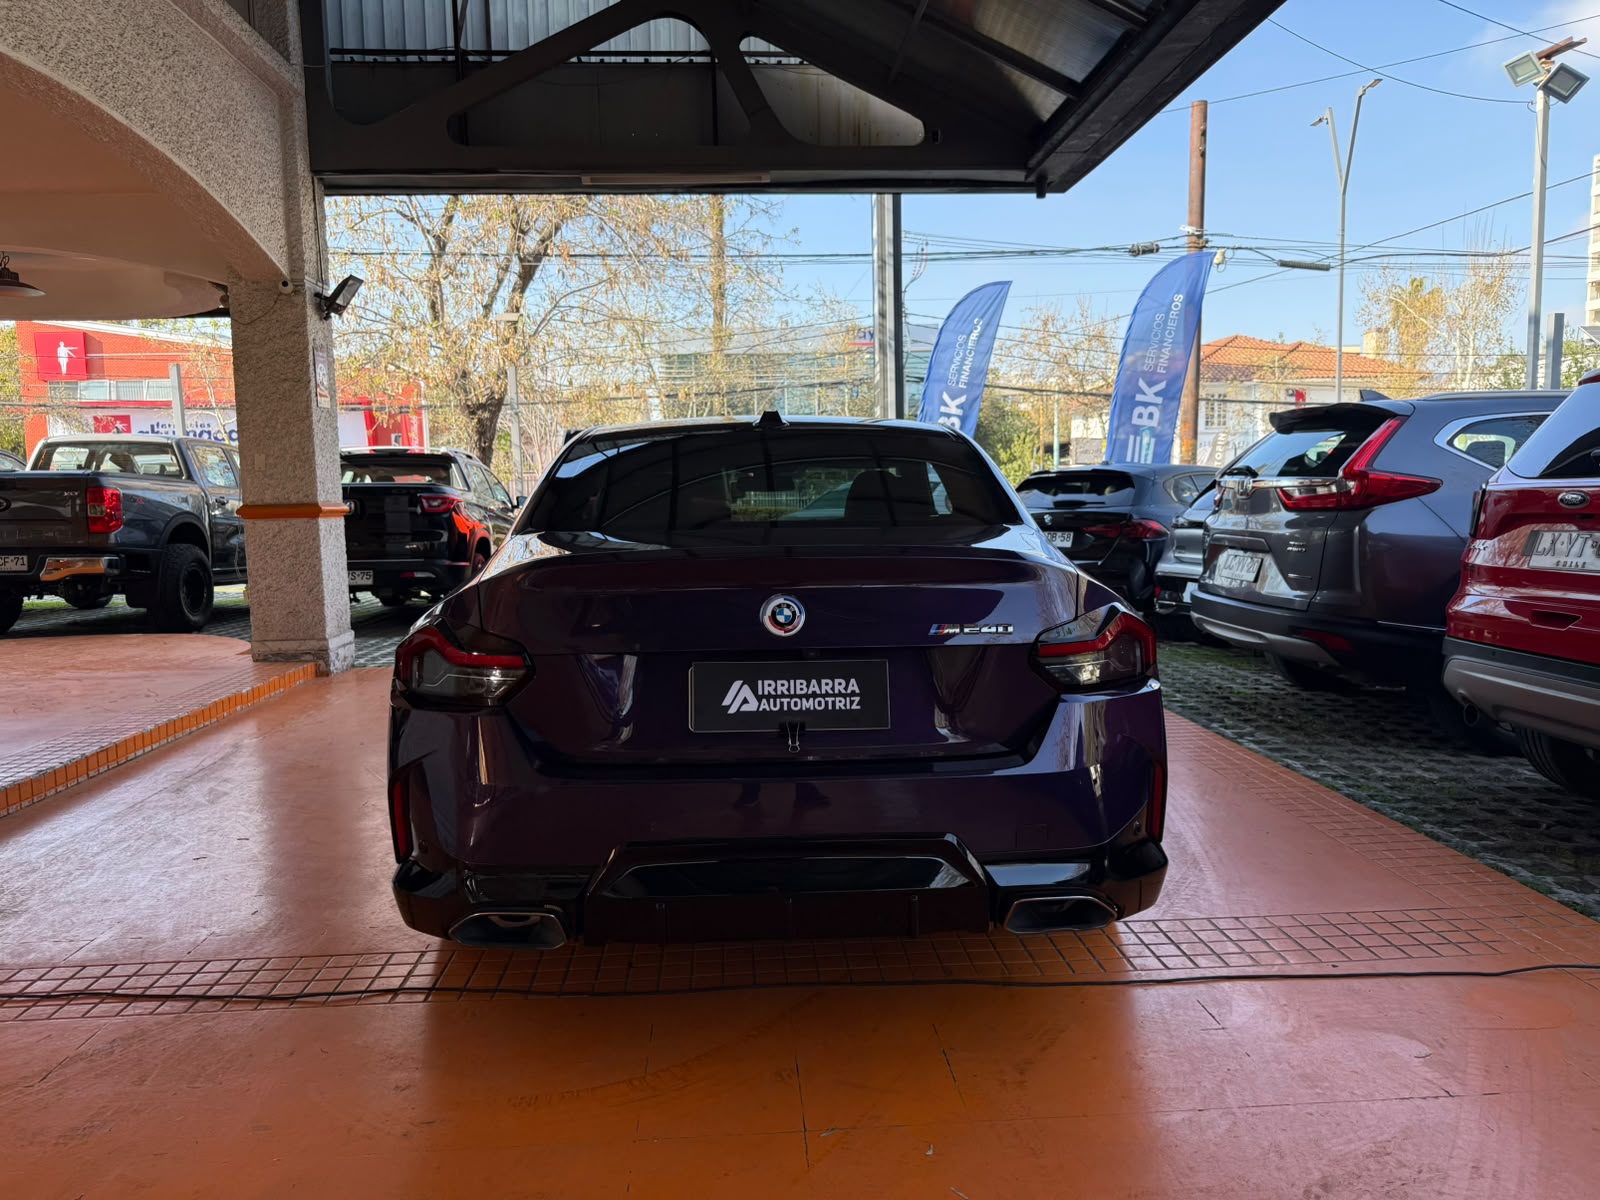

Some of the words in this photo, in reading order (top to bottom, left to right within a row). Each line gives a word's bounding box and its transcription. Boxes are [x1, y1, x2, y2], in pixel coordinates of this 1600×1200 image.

[947, 334, 967, 386] SERVICIOS
[958, 318, 982, 389] FINANCIEROS
[1144, 312, 1165, 372] SERVICIOS
[1157, 294, 1184, 373] FINANCIEROS
[757, 678, 861, 695] IRRIBARRA
[758, 696, 861, 712] AUTOMOTRIZ
